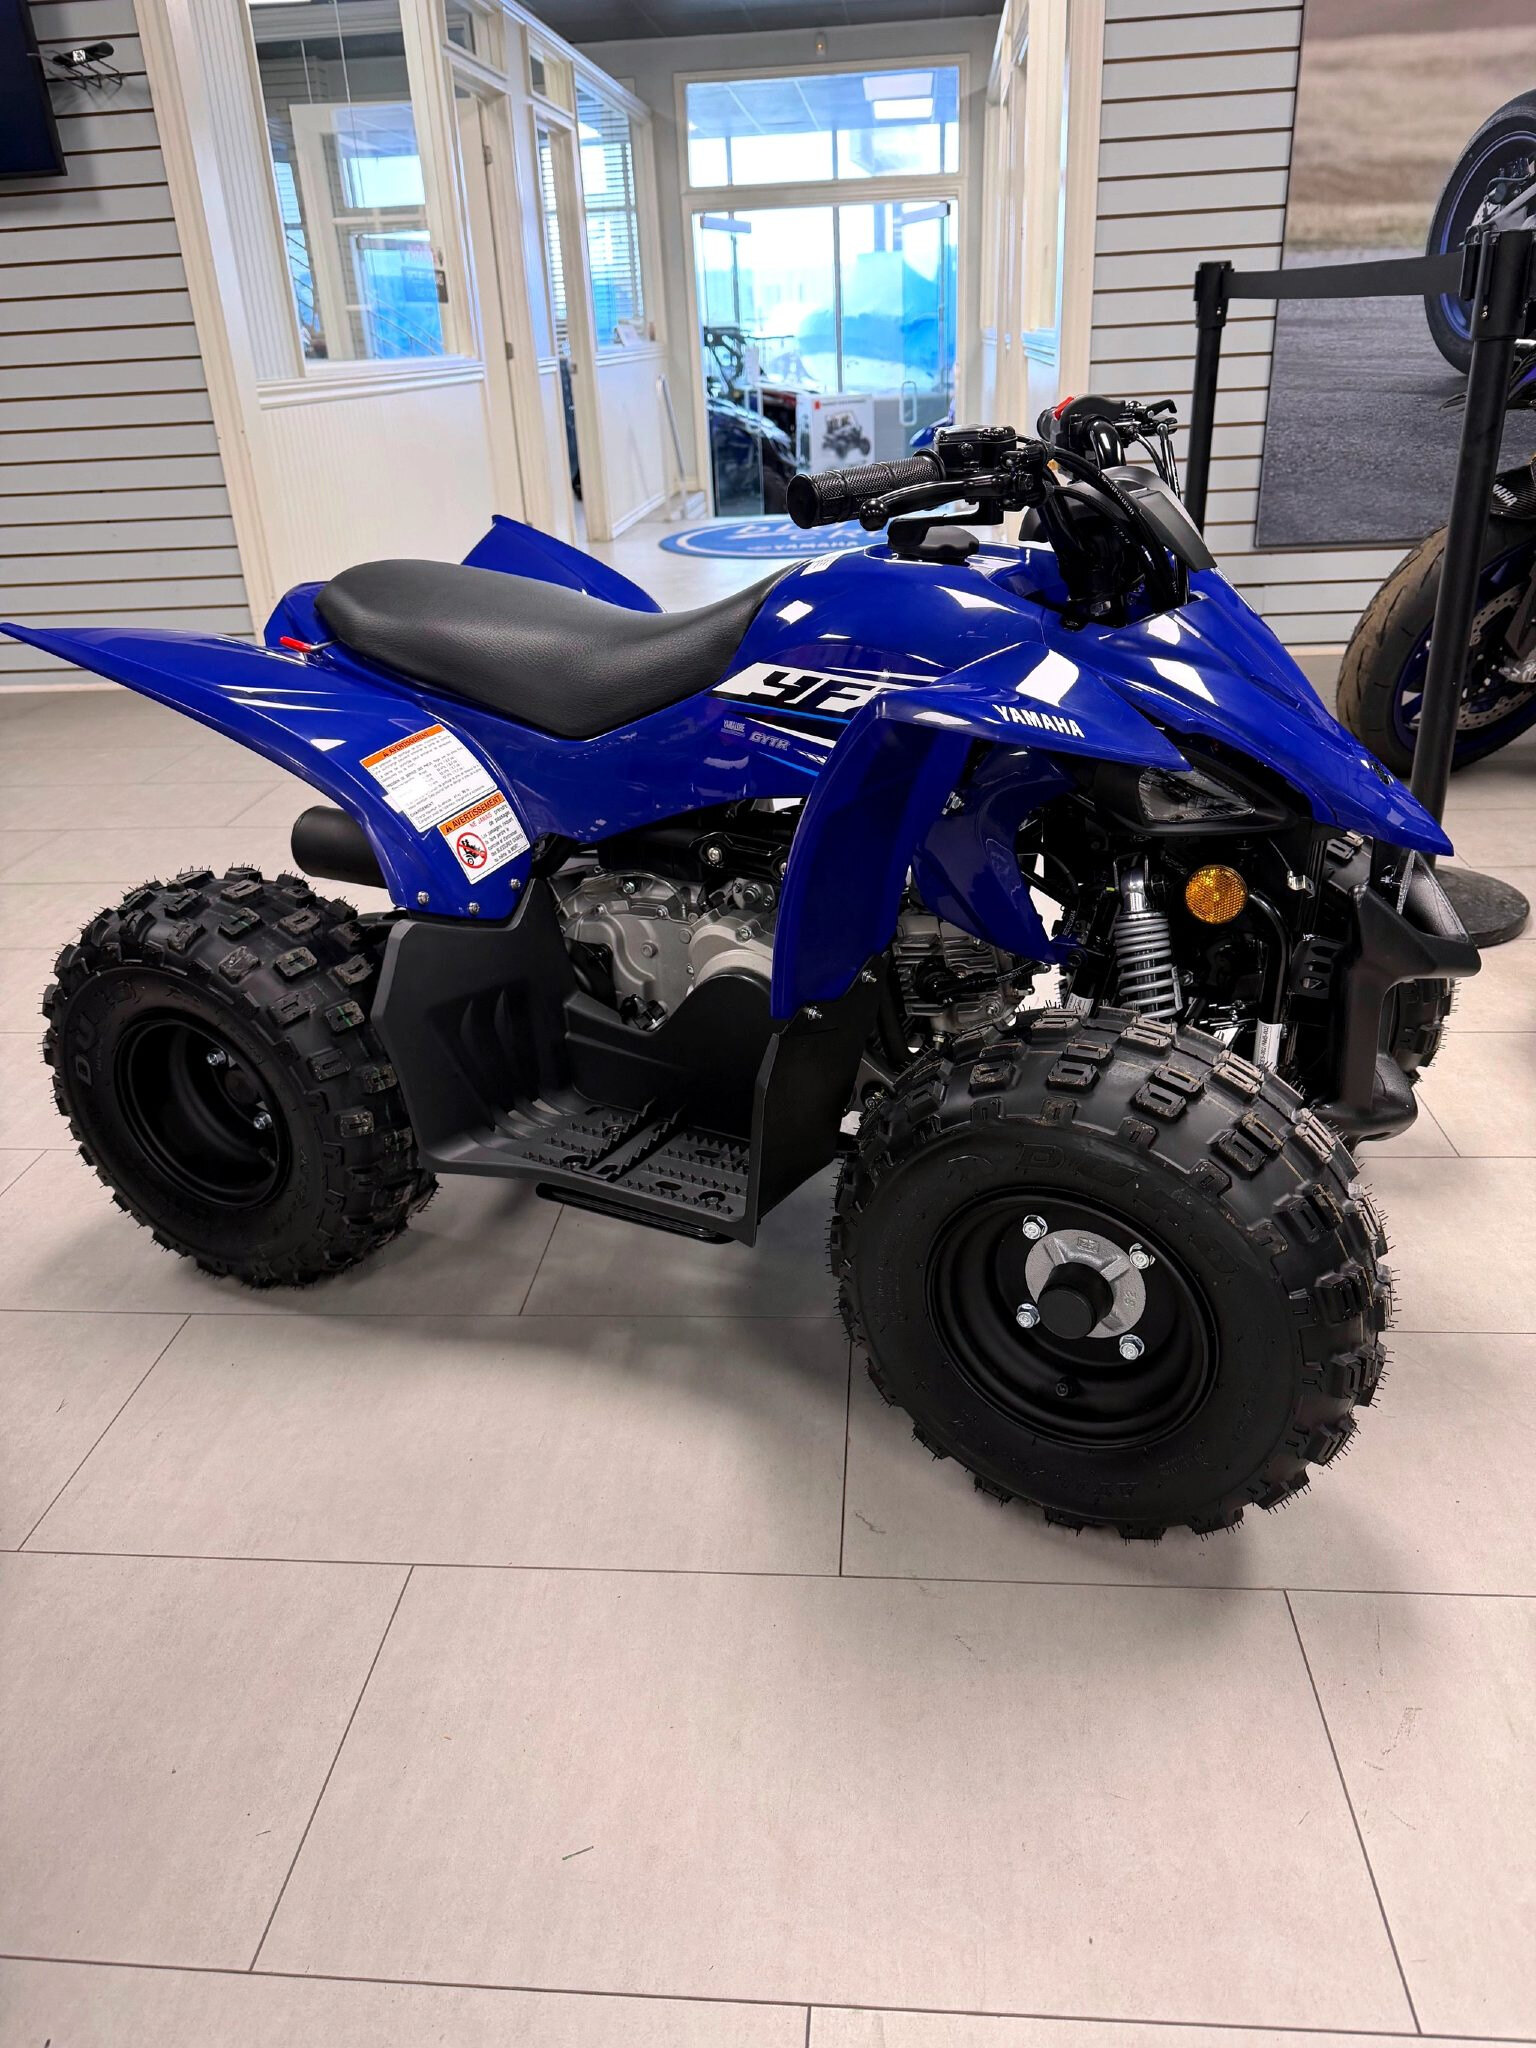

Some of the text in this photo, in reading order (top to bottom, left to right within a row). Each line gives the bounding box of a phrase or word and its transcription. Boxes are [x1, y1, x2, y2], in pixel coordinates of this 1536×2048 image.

[1493, 483, 1519, 507] MAHA
[991, 703, 1085, 738] YAMAHA
[749, 731, 791, 752] GYTR
[451, 794, 502, 829] AVERTISSEMENT
